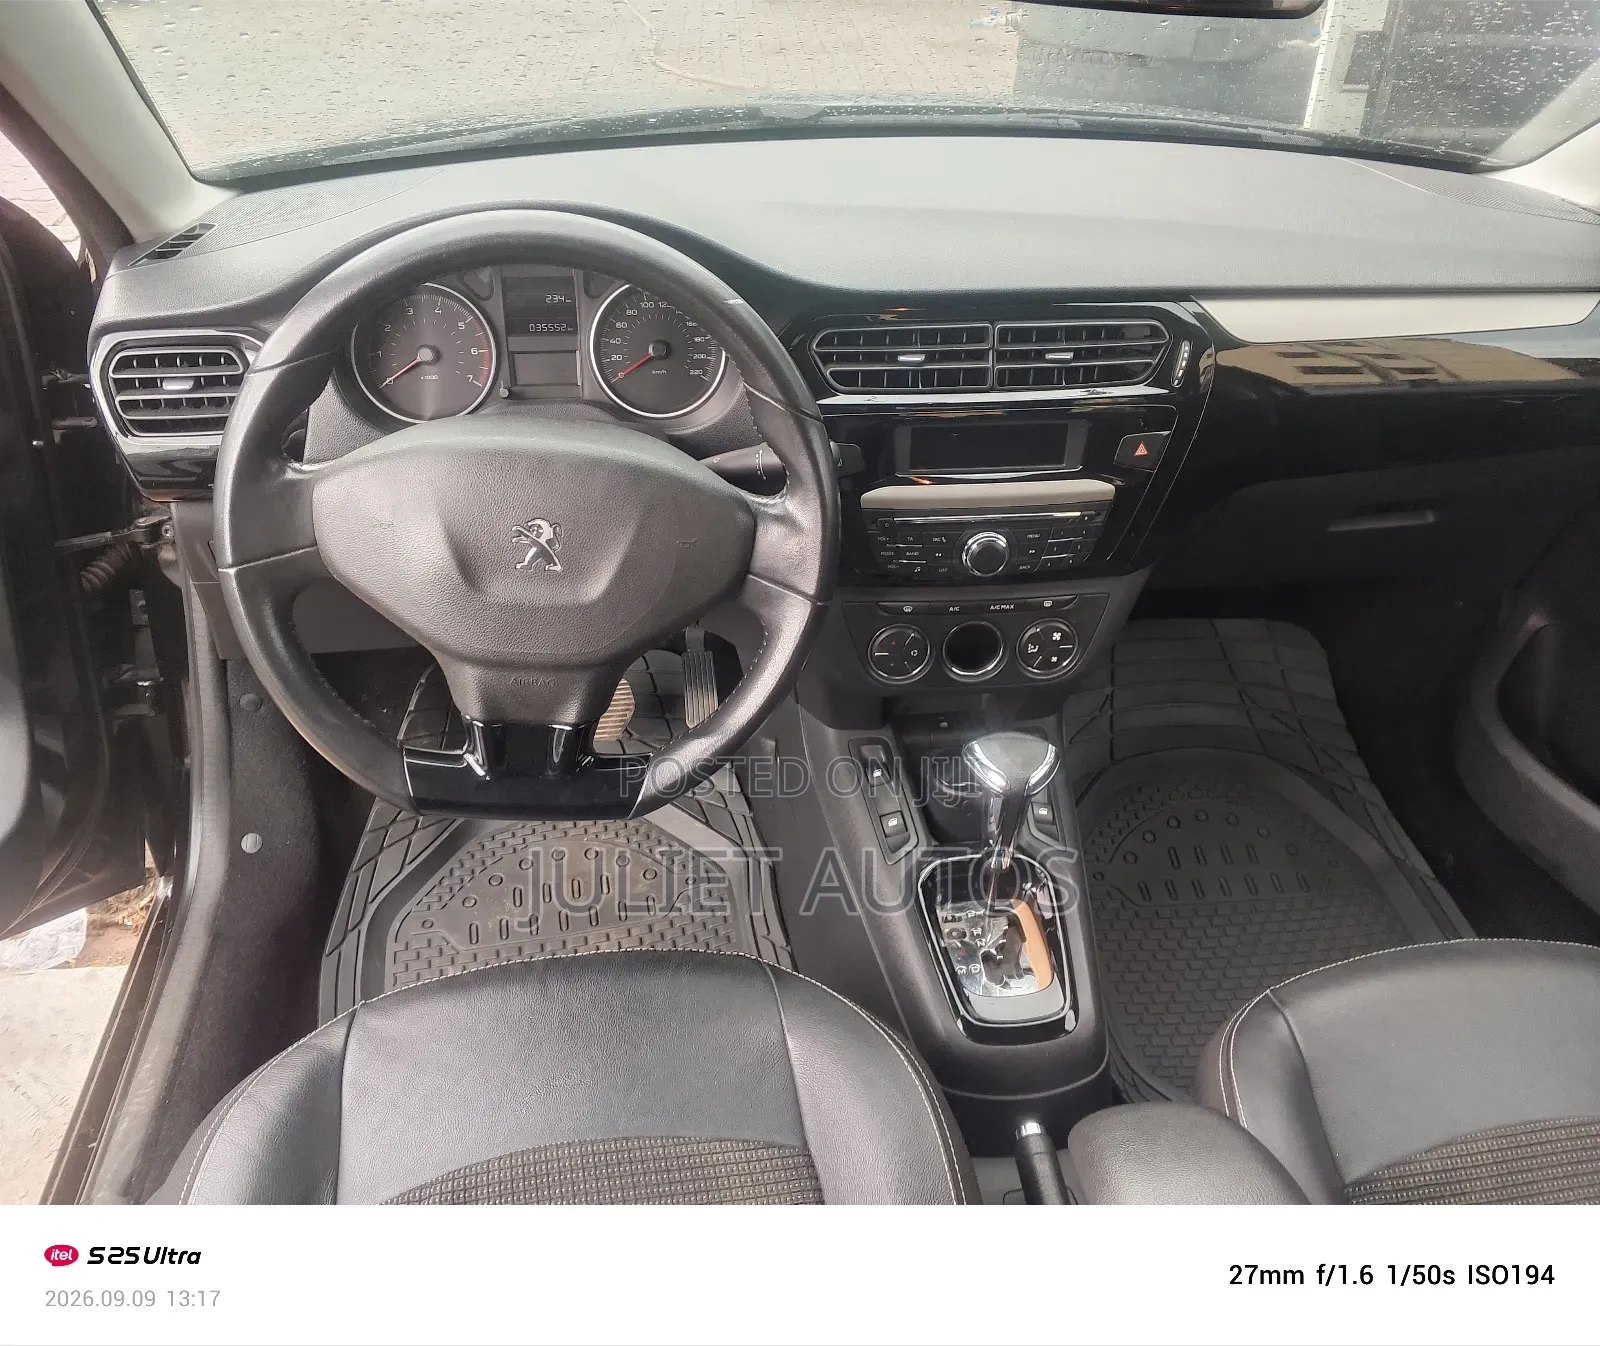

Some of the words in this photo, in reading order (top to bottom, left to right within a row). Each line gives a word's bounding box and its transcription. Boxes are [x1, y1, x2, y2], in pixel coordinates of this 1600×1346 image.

[546, 294, 564, 303] 234
[406, 307, 414, 315] 3
[458, 322, 465, 330] 5
[529, 323, 567, 331] 035552
[470, 347, 478, 355] 6
[509, 676, 556, 686] AIRBAG
